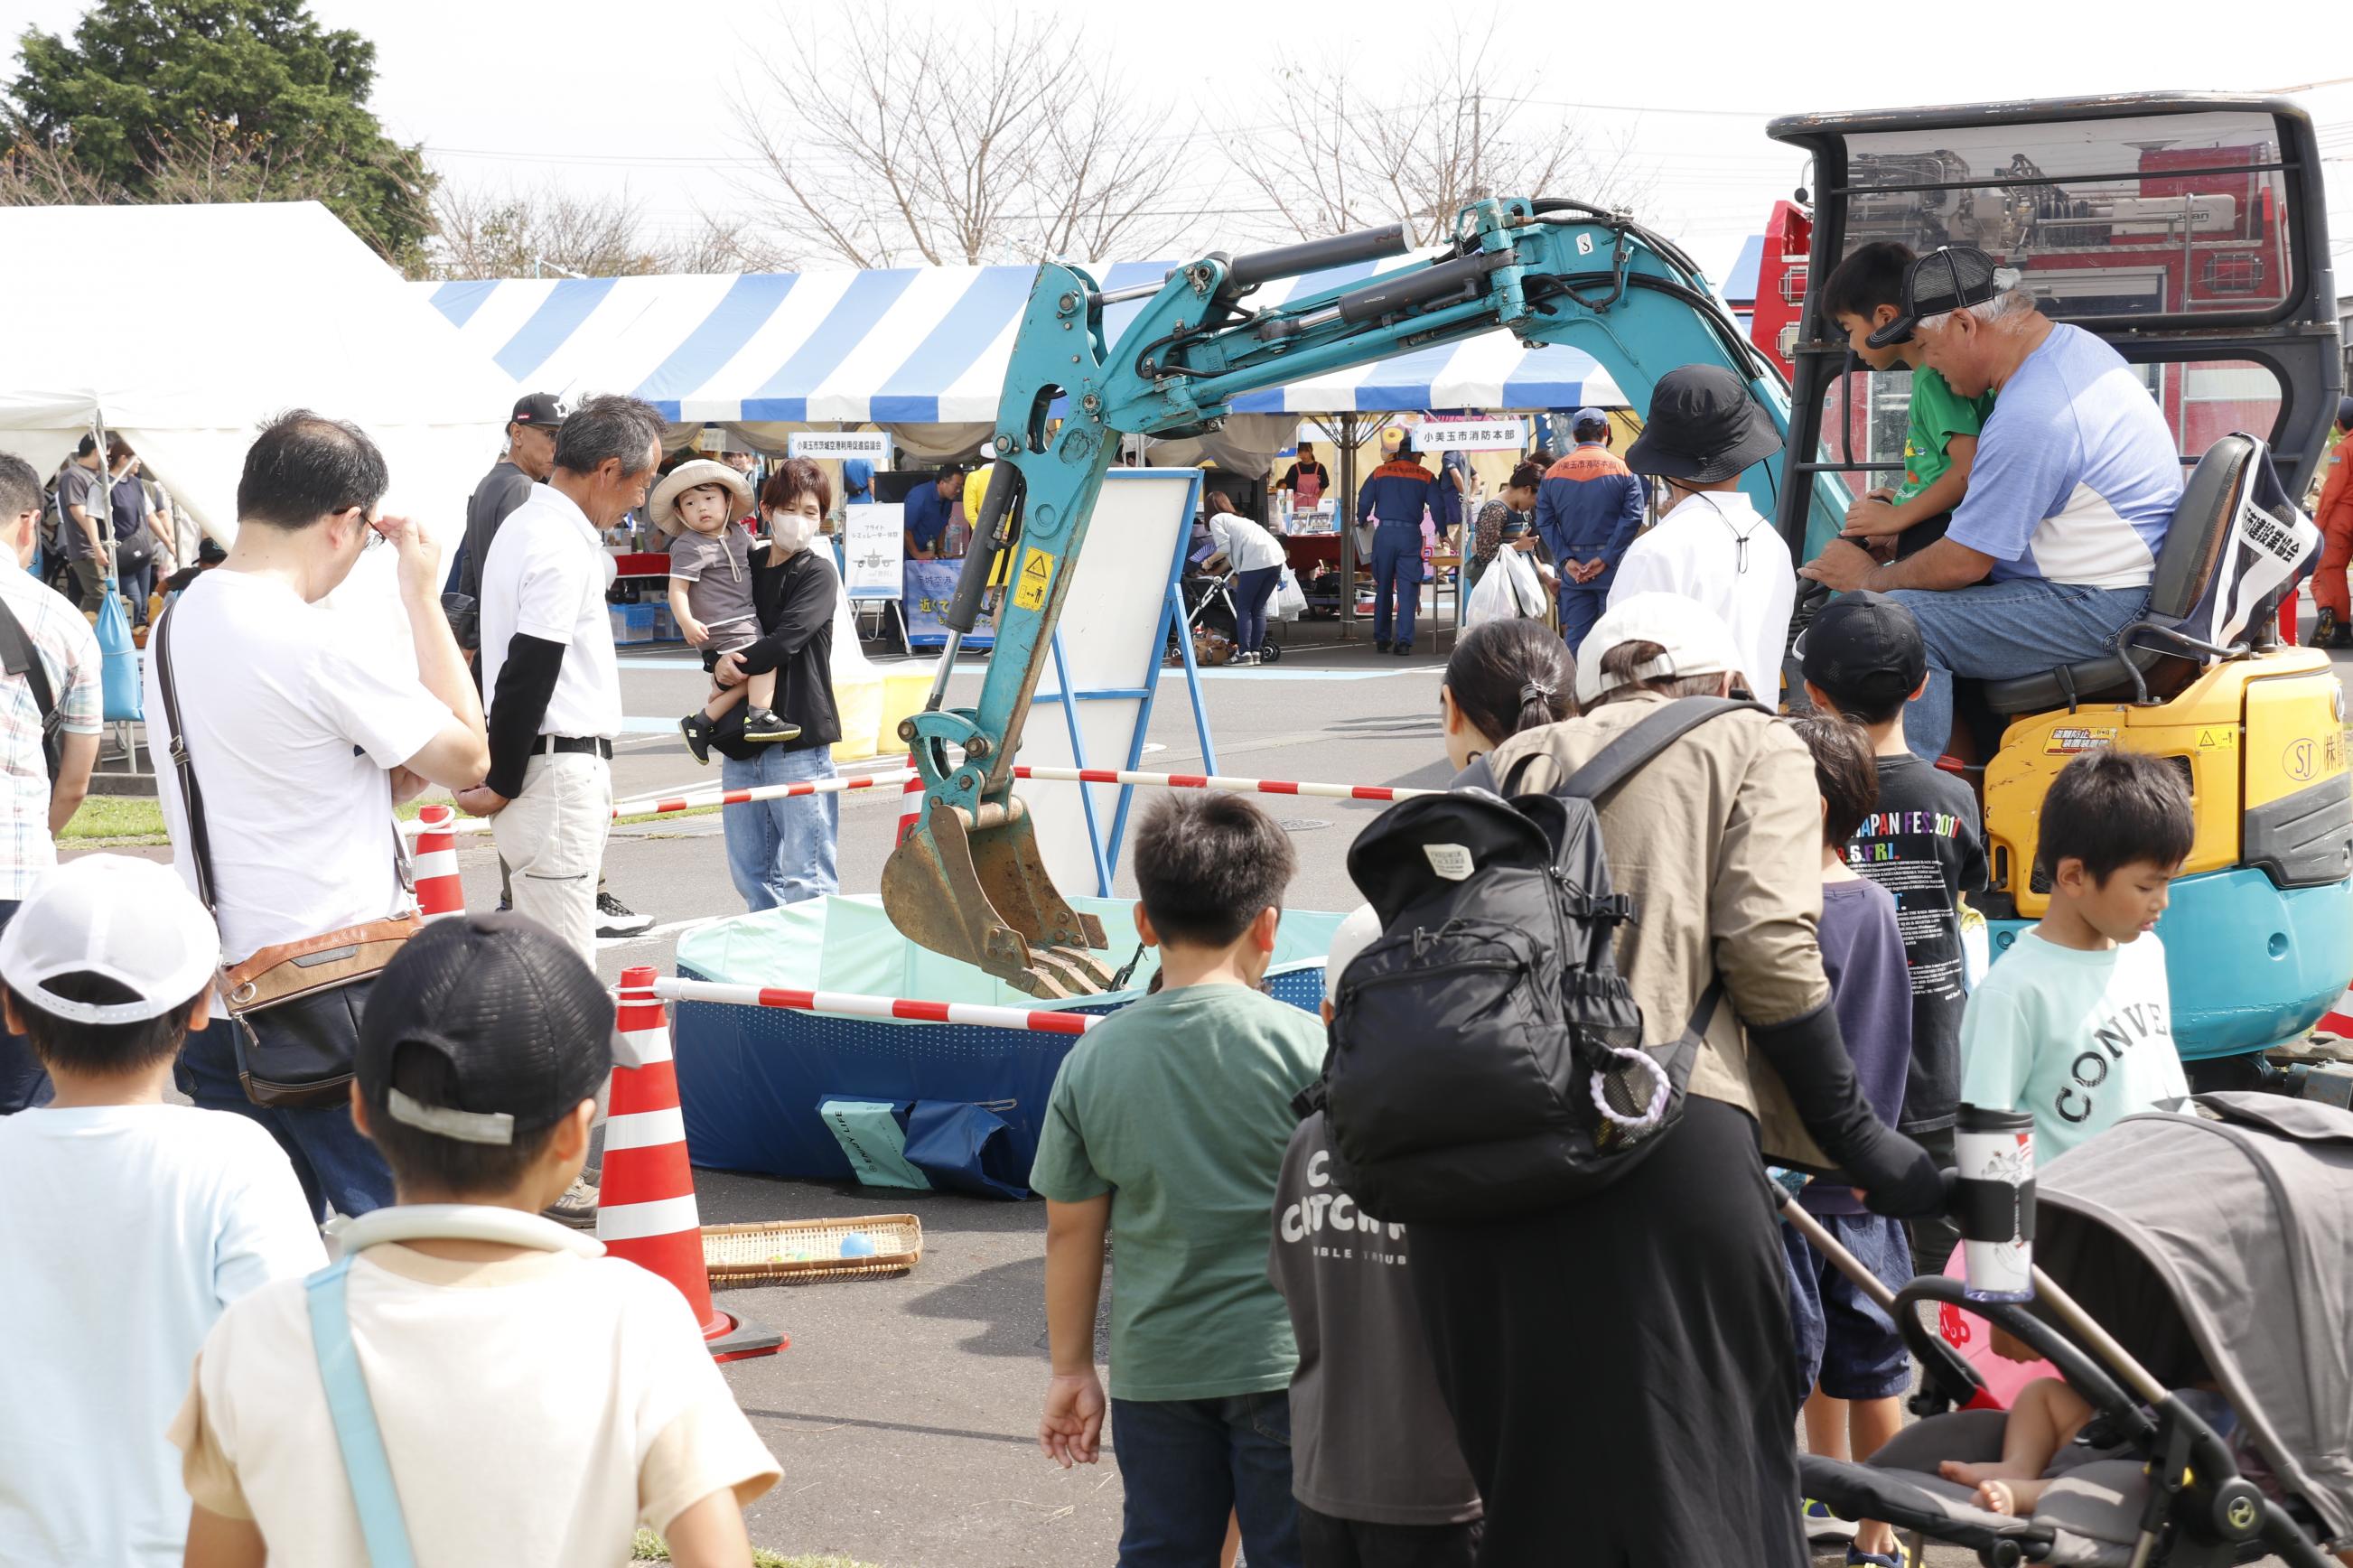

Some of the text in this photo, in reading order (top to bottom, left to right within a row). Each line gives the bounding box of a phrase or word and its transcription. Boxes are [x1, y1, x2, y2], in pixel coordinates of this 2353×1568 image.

[797, 440, 882, 451] 小美玉市茨城空港利用促進協議会
[1424, 429, 1515, 443] 小美玉市消防本部
[2295, 743, 2312, 778] SJ
[2055, 1003, 2168, 1124] CONVE
[836, 1110, 851, 1133] LIFE
